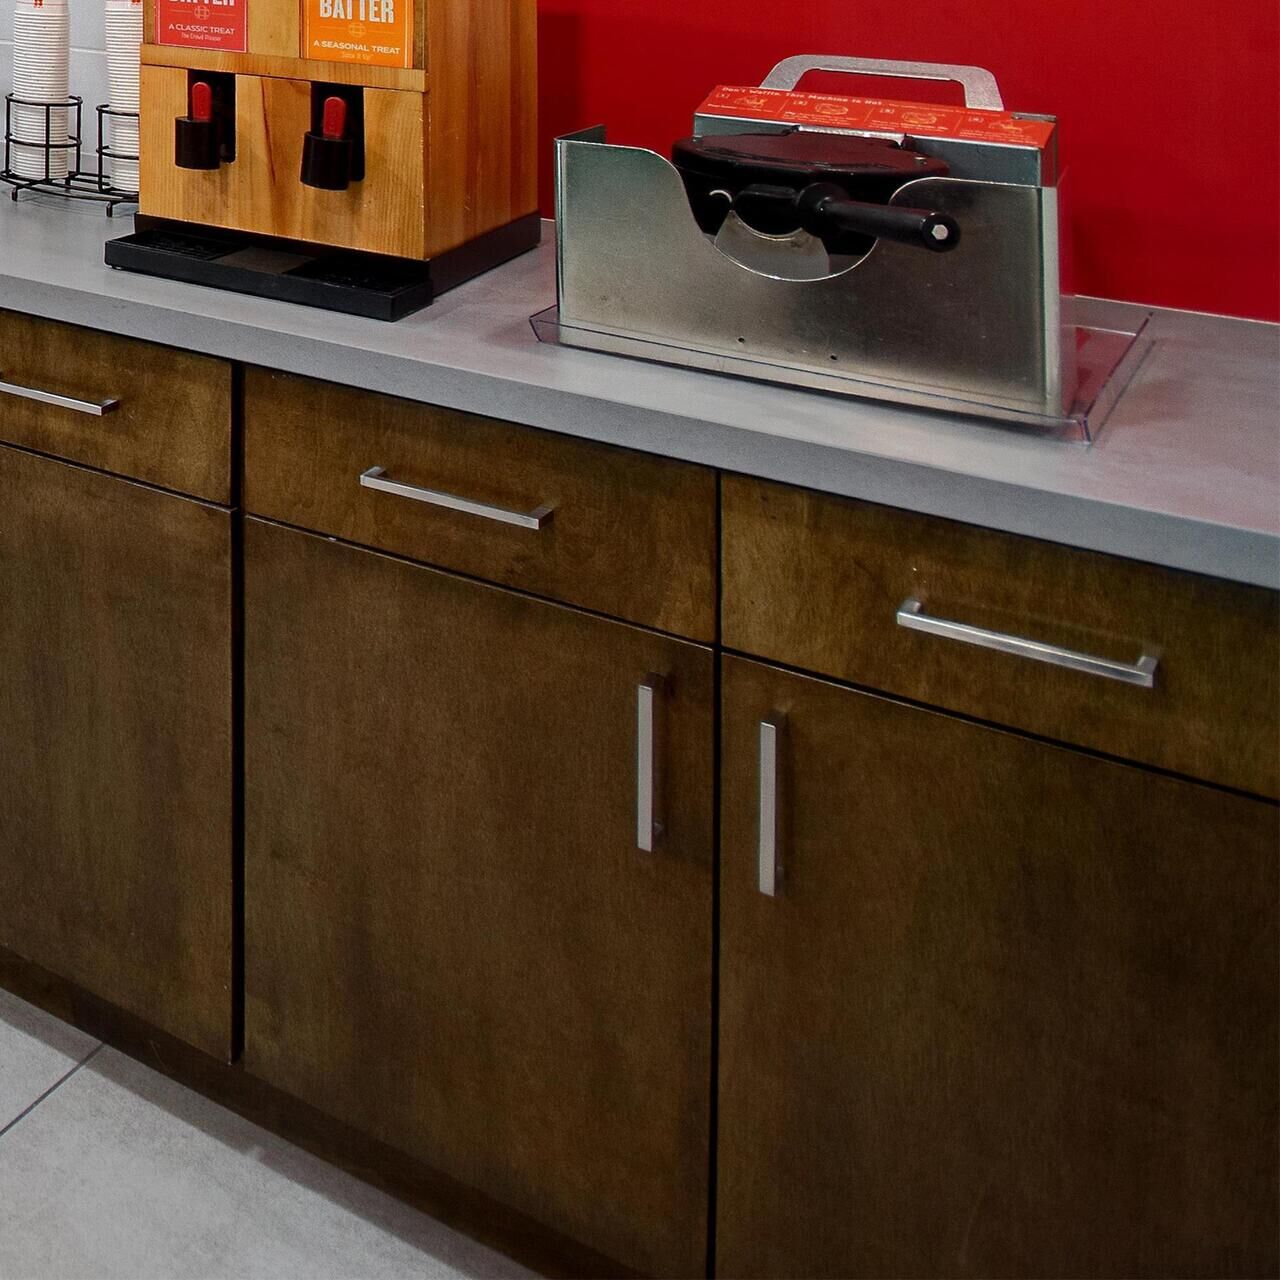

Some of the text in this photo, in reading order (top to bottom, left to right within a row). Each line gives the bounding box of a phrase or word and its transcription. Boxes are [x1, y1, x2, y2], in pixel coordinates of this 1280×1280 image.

[176, 24, 208, 33] CLASSIC
[210, 27, 235, 35] TREAT
[321, 40, 369, 52] SEASONAL
[372, 46, 400, 55] TREAT
[808, 94, 848, 103] Machine
